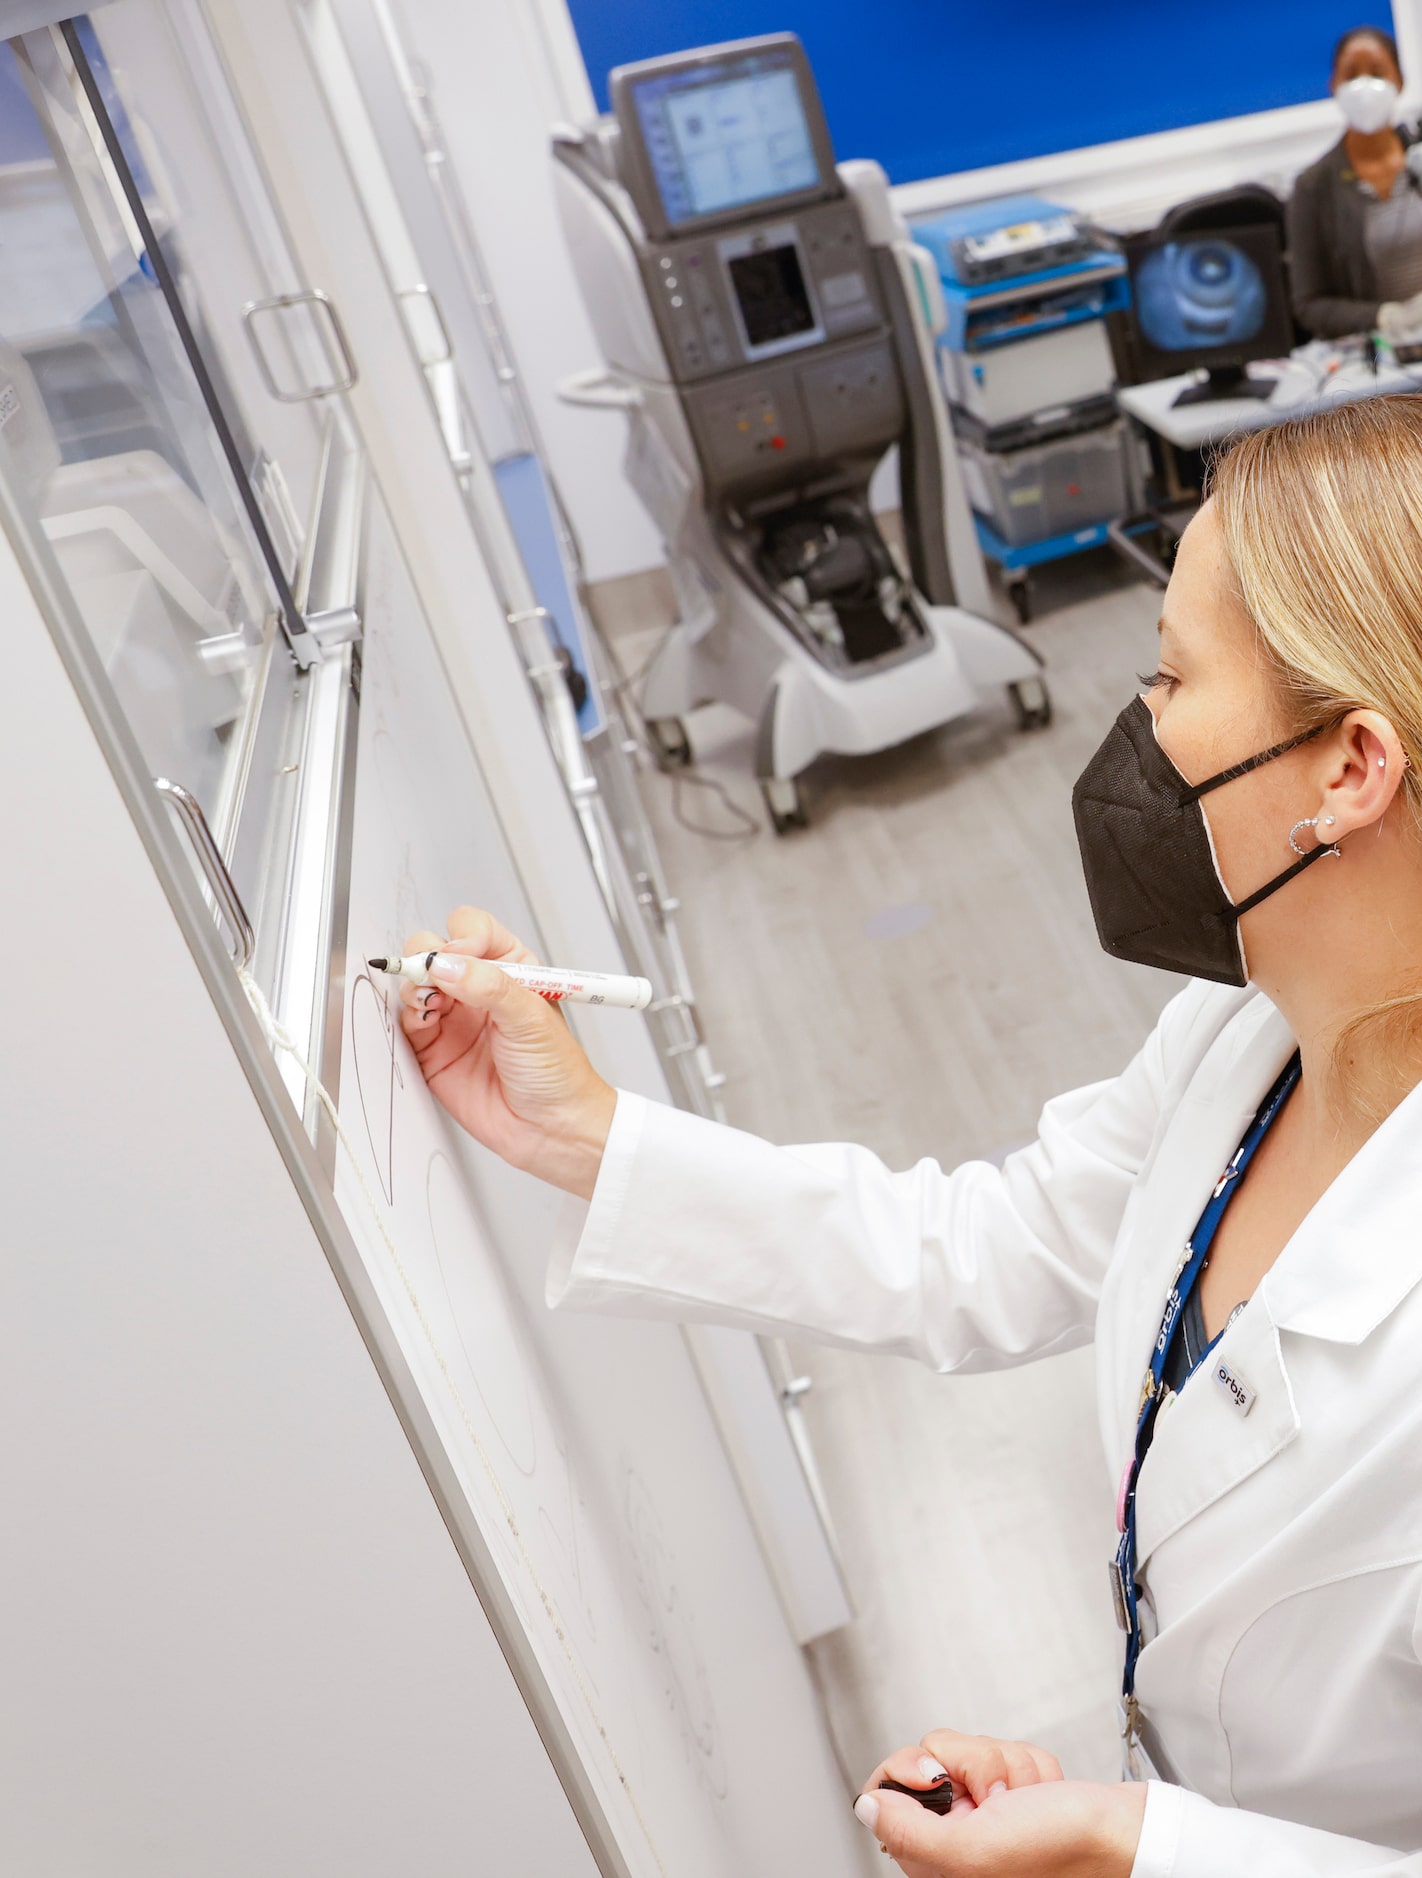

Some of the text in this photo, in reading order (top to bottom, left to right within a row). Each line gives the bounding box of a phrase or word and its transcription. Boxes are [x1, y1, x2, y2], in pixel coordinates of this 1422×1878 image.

[528, 979, 564, 989] CAP-OFF
[567, 984, 585, 993] TIME
[1157, 1288, 1180, 1352] orbis
[1217, 1367, 1247, 1405] orbis
